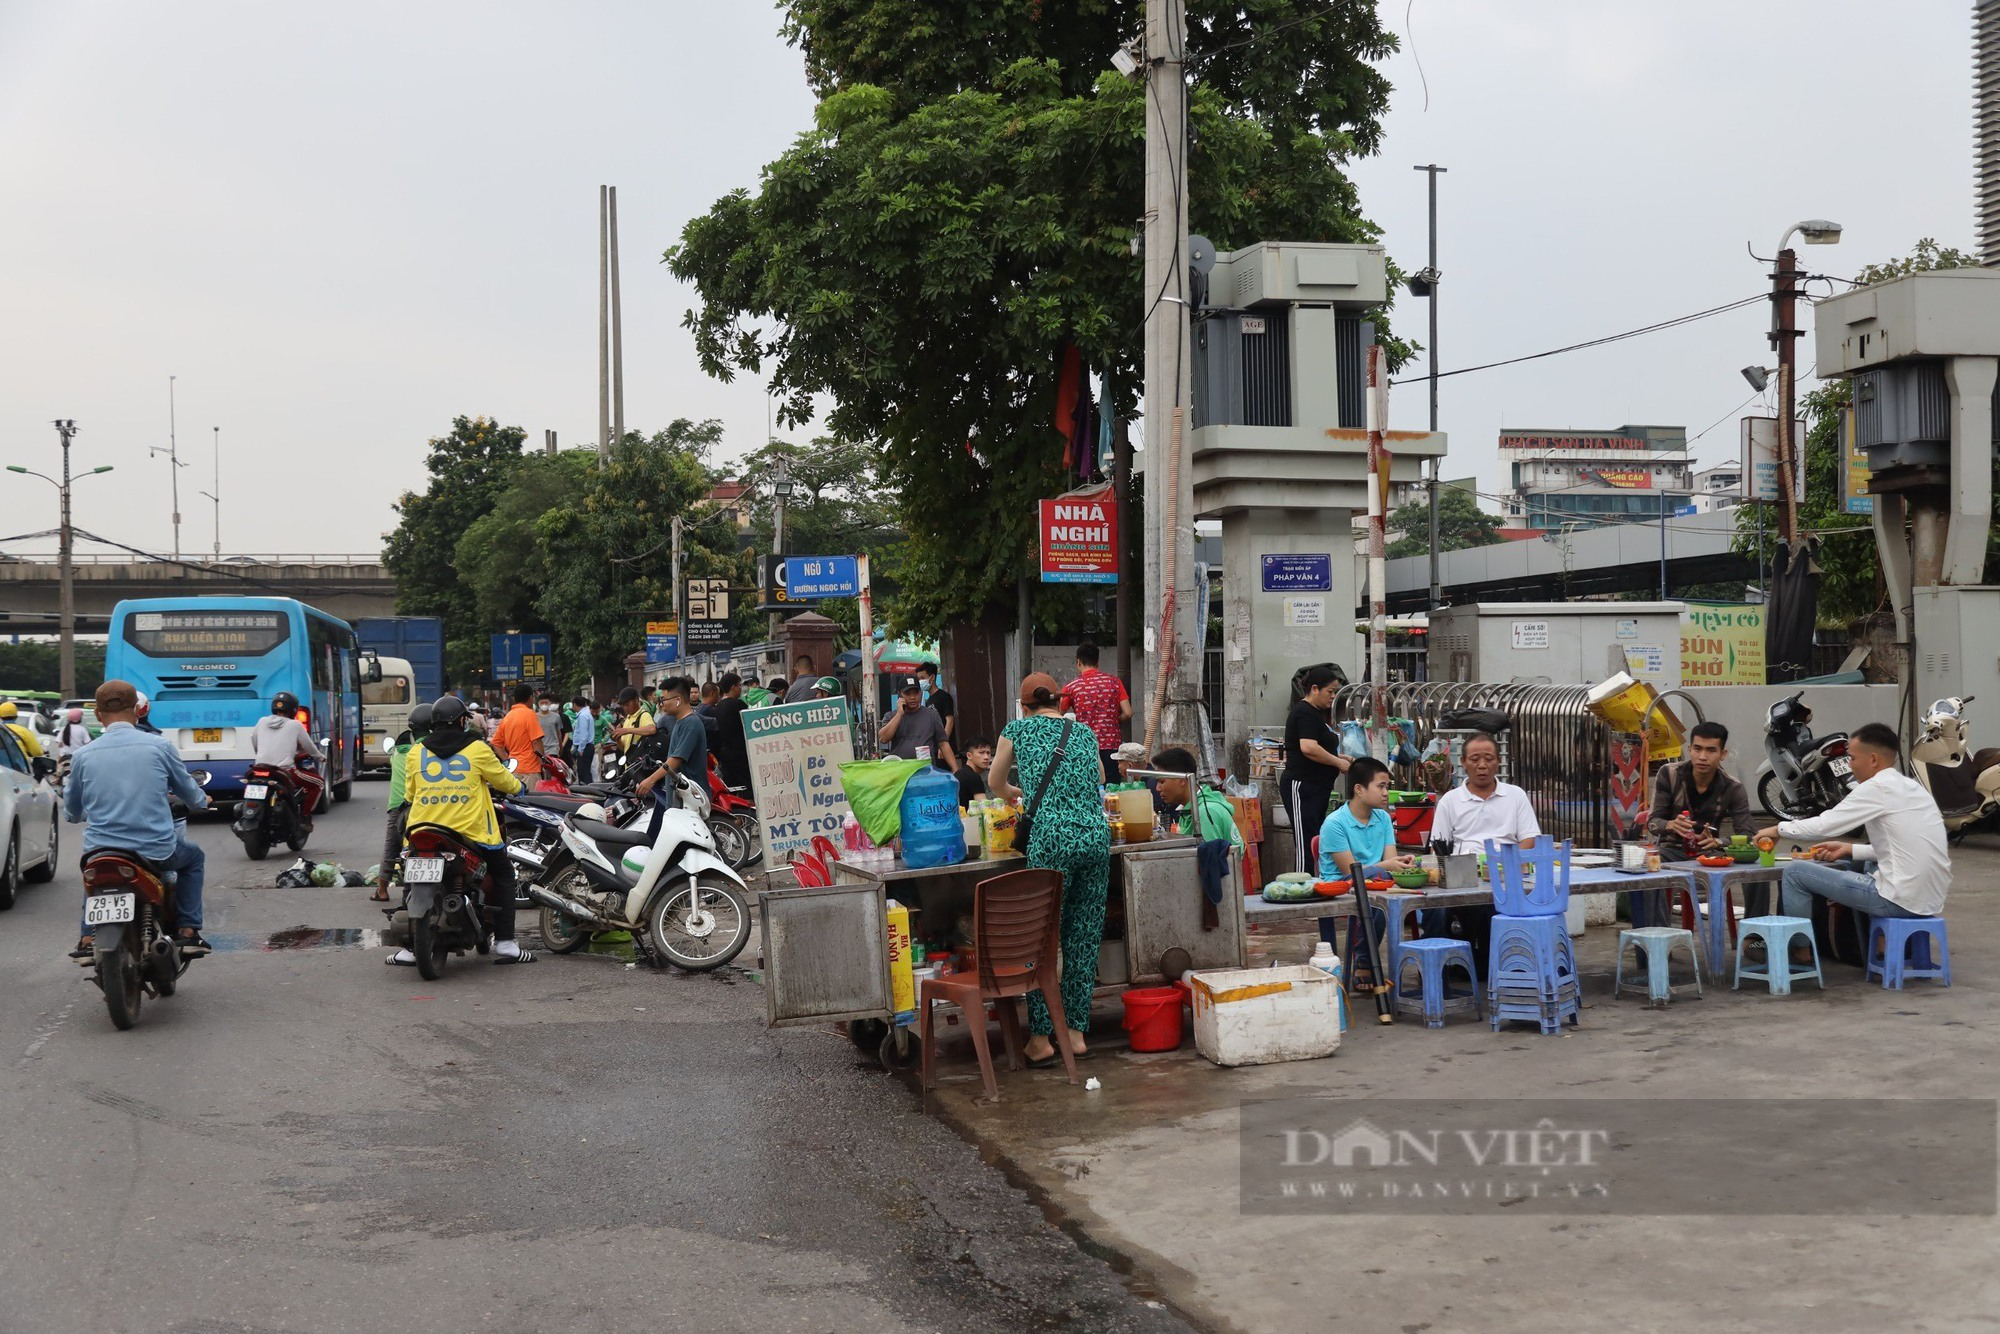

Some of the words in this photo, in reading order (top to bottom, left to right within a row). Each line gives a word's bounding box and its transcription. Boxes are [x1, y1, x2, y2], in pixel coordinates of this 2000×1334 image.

[1243, 321, 1264, 329] AGE
[1608, 436, 1645, 450] VINH
[1054, 503, 1105, 521] NHÀ
[1050, 522, 1110, 542] NGHỈ
[804, 560, 822, 577] NGÕ
[829, 561, 835, 575] 3
[1273, 573, 1295, 581] PHÁP
[1296, 573, 1313, 581] VÂN
[794, 582, 818, 593] ĐƯỜNG
[819, 582, 839, 593] NGỌC
[164, 633, 187, 643] BUS
[189, 631, 213, 643] LIÊN
[217, 633, 246, 643] NINH
[1680, 634, 1723, 655] BÚN
[1681, 657, 1724, 676] PHỞ
[821, 682, 833, 690] Grab
[750, 711, 804, 733] CƯỜNG
[806, 704, 842, 725] HIỆP
[754, 736, 795, 756] NHÀ
[799, 726, 846, 749] NGHỈ
[420, 747, 471, 783] be
[758, 753, 795, 788] PHỞ
[807, 755, 827, 771] Bò
[810, 772, 833, 789] Gà
[763, 790, 802, 821] BÚN
[918, 799, 954, 816] LanKa
[769, 818, 802, 841] MỲ
[407, 870, 441, 881] 067.32
[93, 896, 126, 910] 29-V5
[89, 908, 130, 922] 001.36
[888, 923, 901, 940] HÀ
[901, 934, 910, 949] BIA
